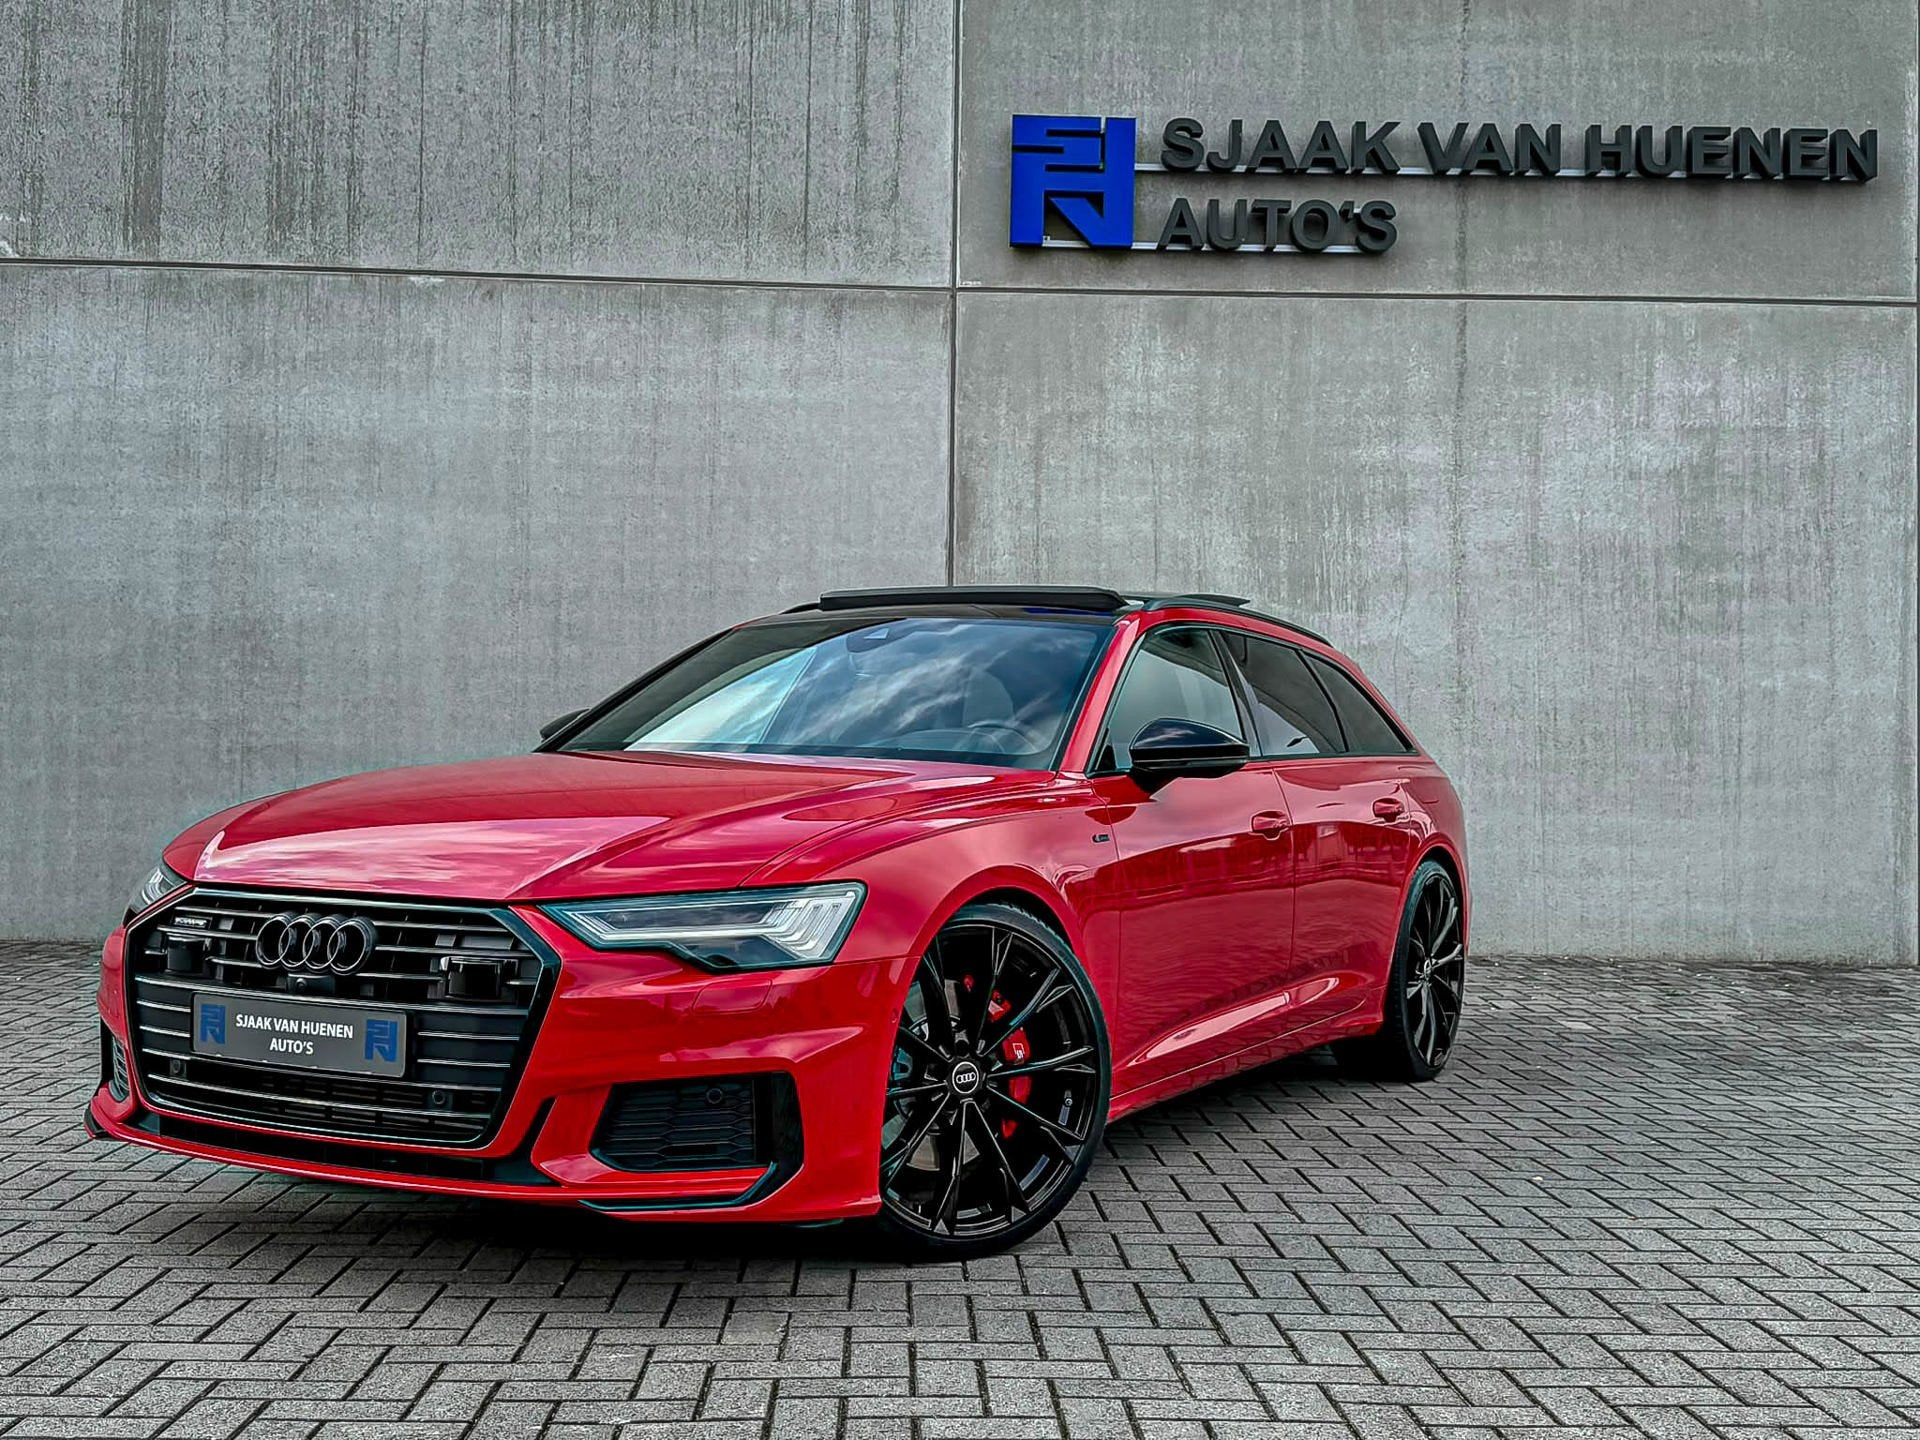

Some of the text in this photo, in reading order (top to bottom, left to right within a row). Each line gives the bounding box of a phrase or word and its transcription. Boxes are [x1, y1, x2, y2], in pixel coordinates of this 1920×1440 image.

[1160, 117, 1879, 183] SJAAK VAN HUENEN
[1156, 197, 1398, 254] AUTO'S
[235, 1013, 273, 1031] SJAAK
[273, 1018, 299, 1033] VAN
[301, 1020, 354, 1039] HUENEN
[269, 1037, 314, 1055] AUTO'S
